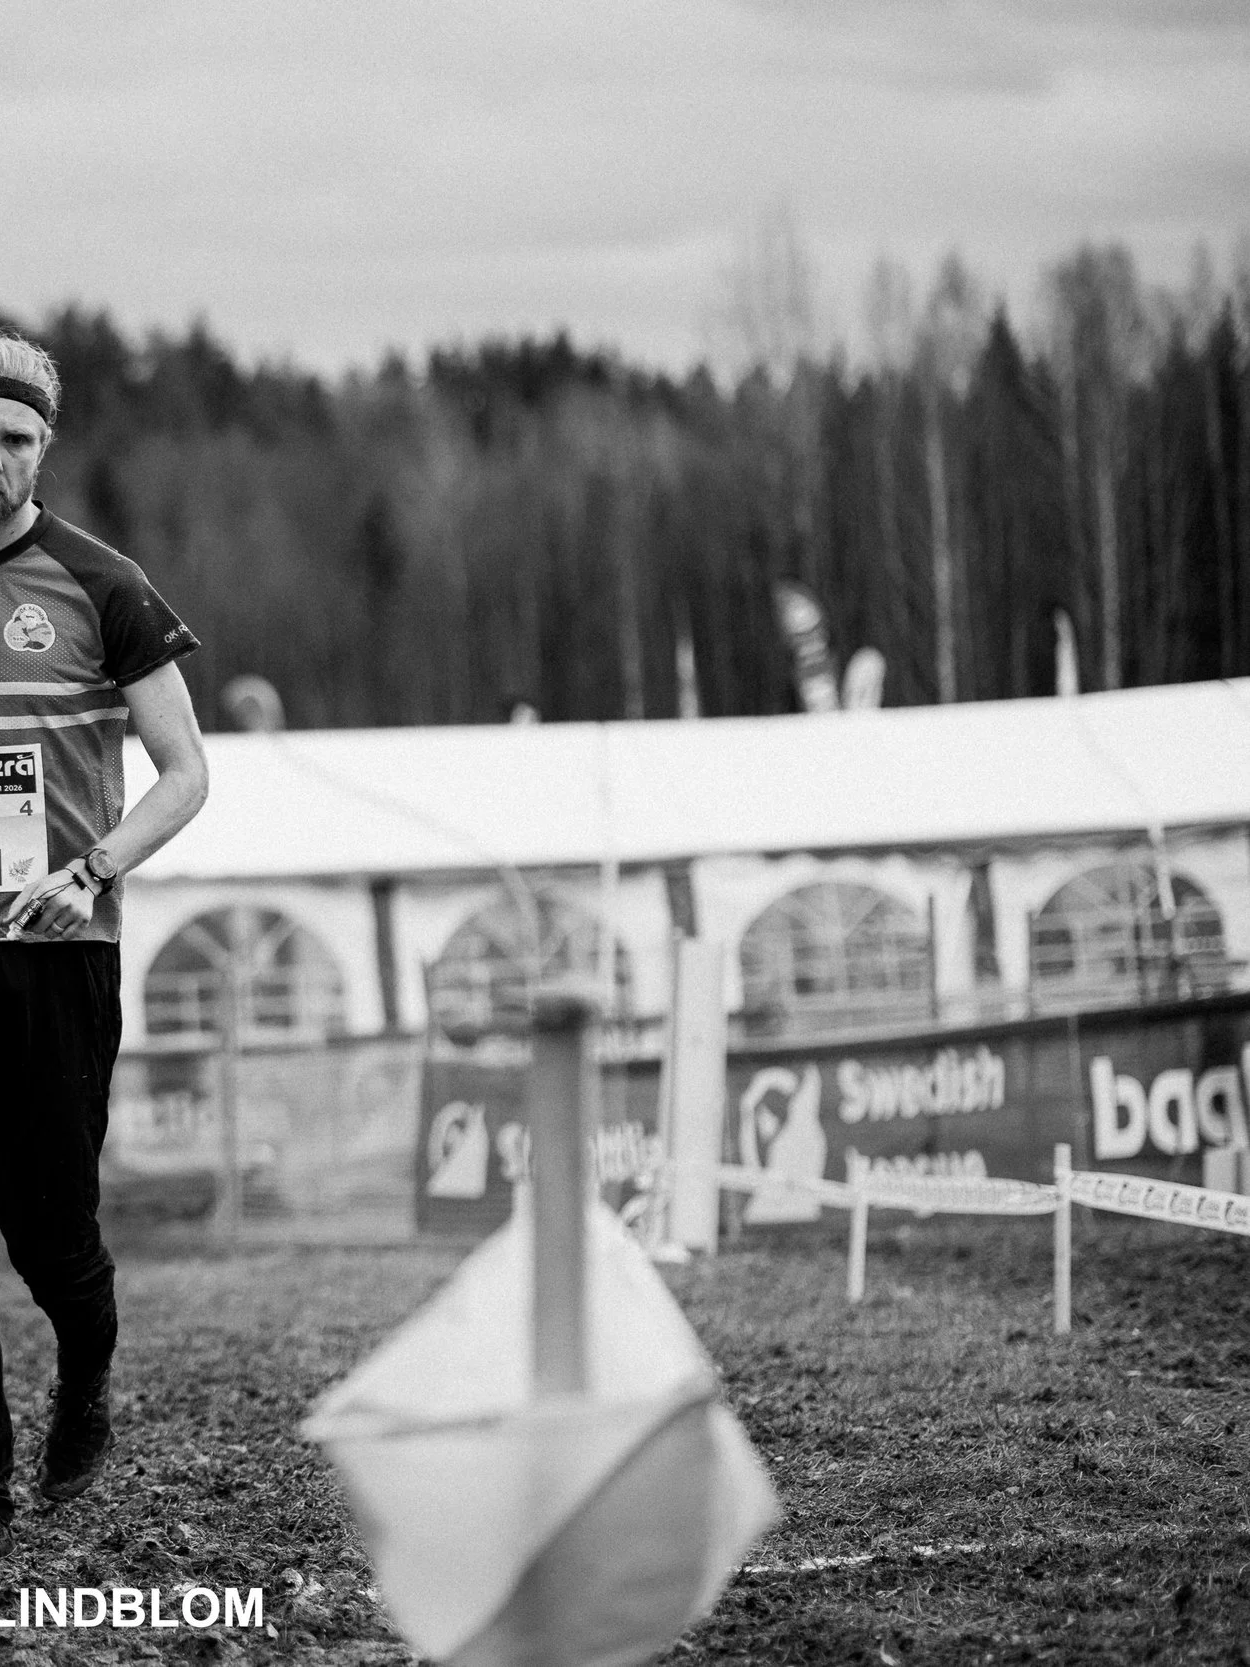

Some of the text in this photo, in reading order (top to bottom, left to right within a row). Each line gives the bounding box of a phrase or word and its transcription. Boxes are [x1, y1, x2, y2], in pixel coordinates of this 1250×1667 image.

[4, 784, 23, 792] 2026
[19, 800, 33, 816] 4
[837, 1043, 1005, 1124] Swedish
[1090, 1032, 1250, 1184] bag
